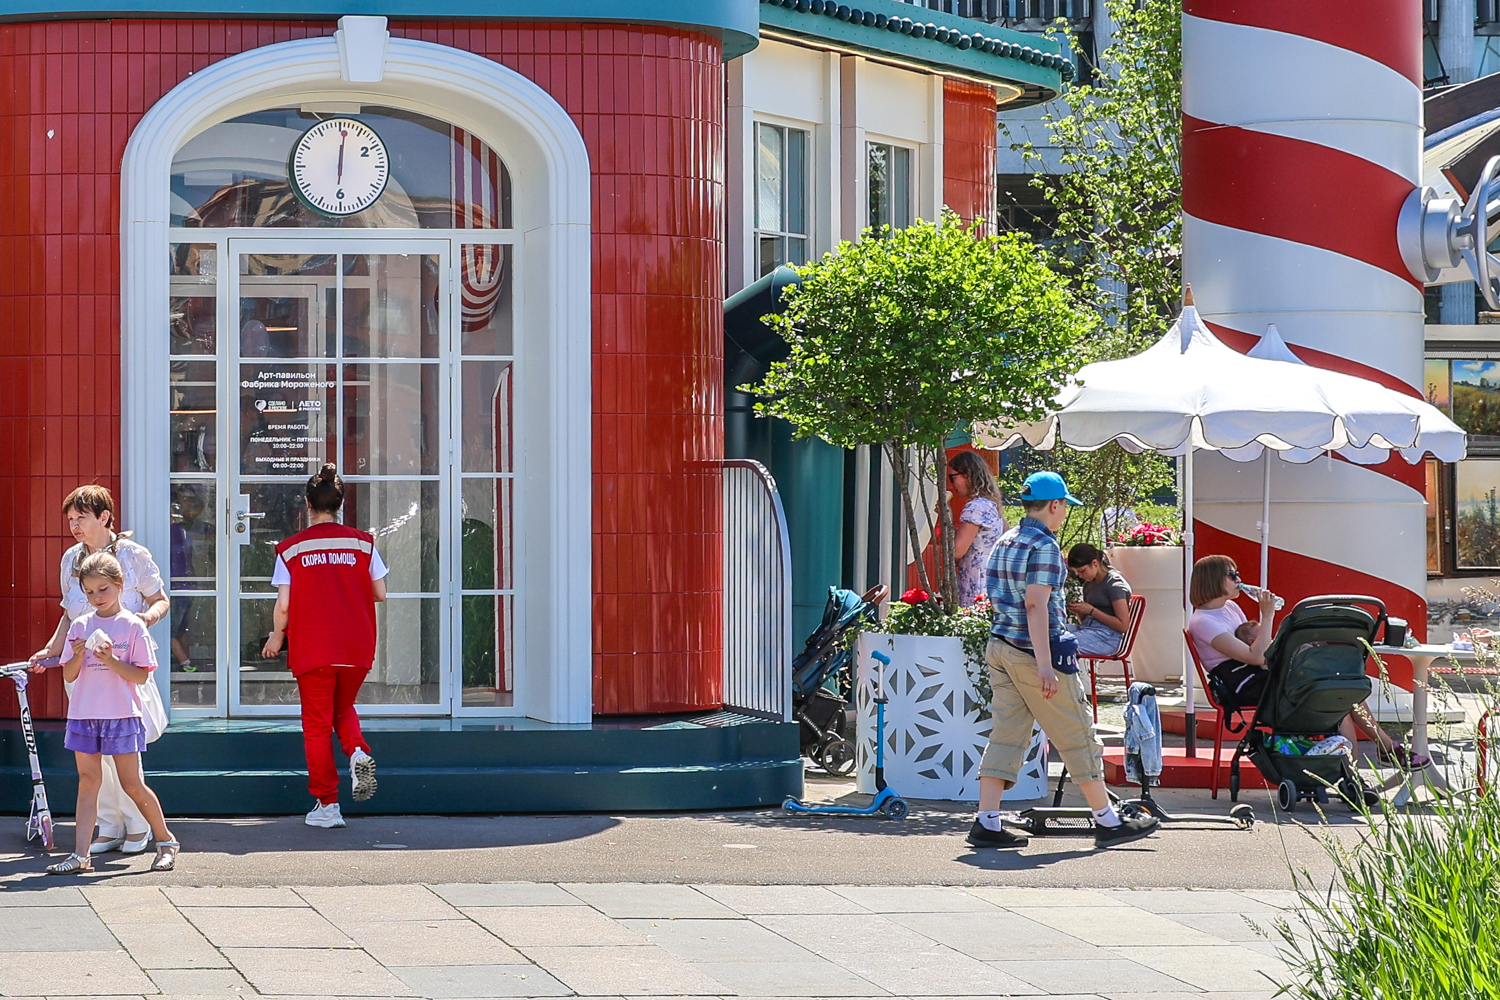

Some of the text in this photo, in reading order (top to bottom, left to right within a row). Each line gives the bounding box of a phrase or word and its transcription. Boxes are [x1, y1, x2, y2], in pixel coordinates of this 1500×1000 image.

[360, 146, 370, 157] 2
[335, 188, 345, 200] 6
[258, 371, 316, 380] Арт-павильон
[241, 380, 335, 389] Фабрика Мороженого
[301, 552, 357, 568] СКОРАЯ ПОМОЩЬ
